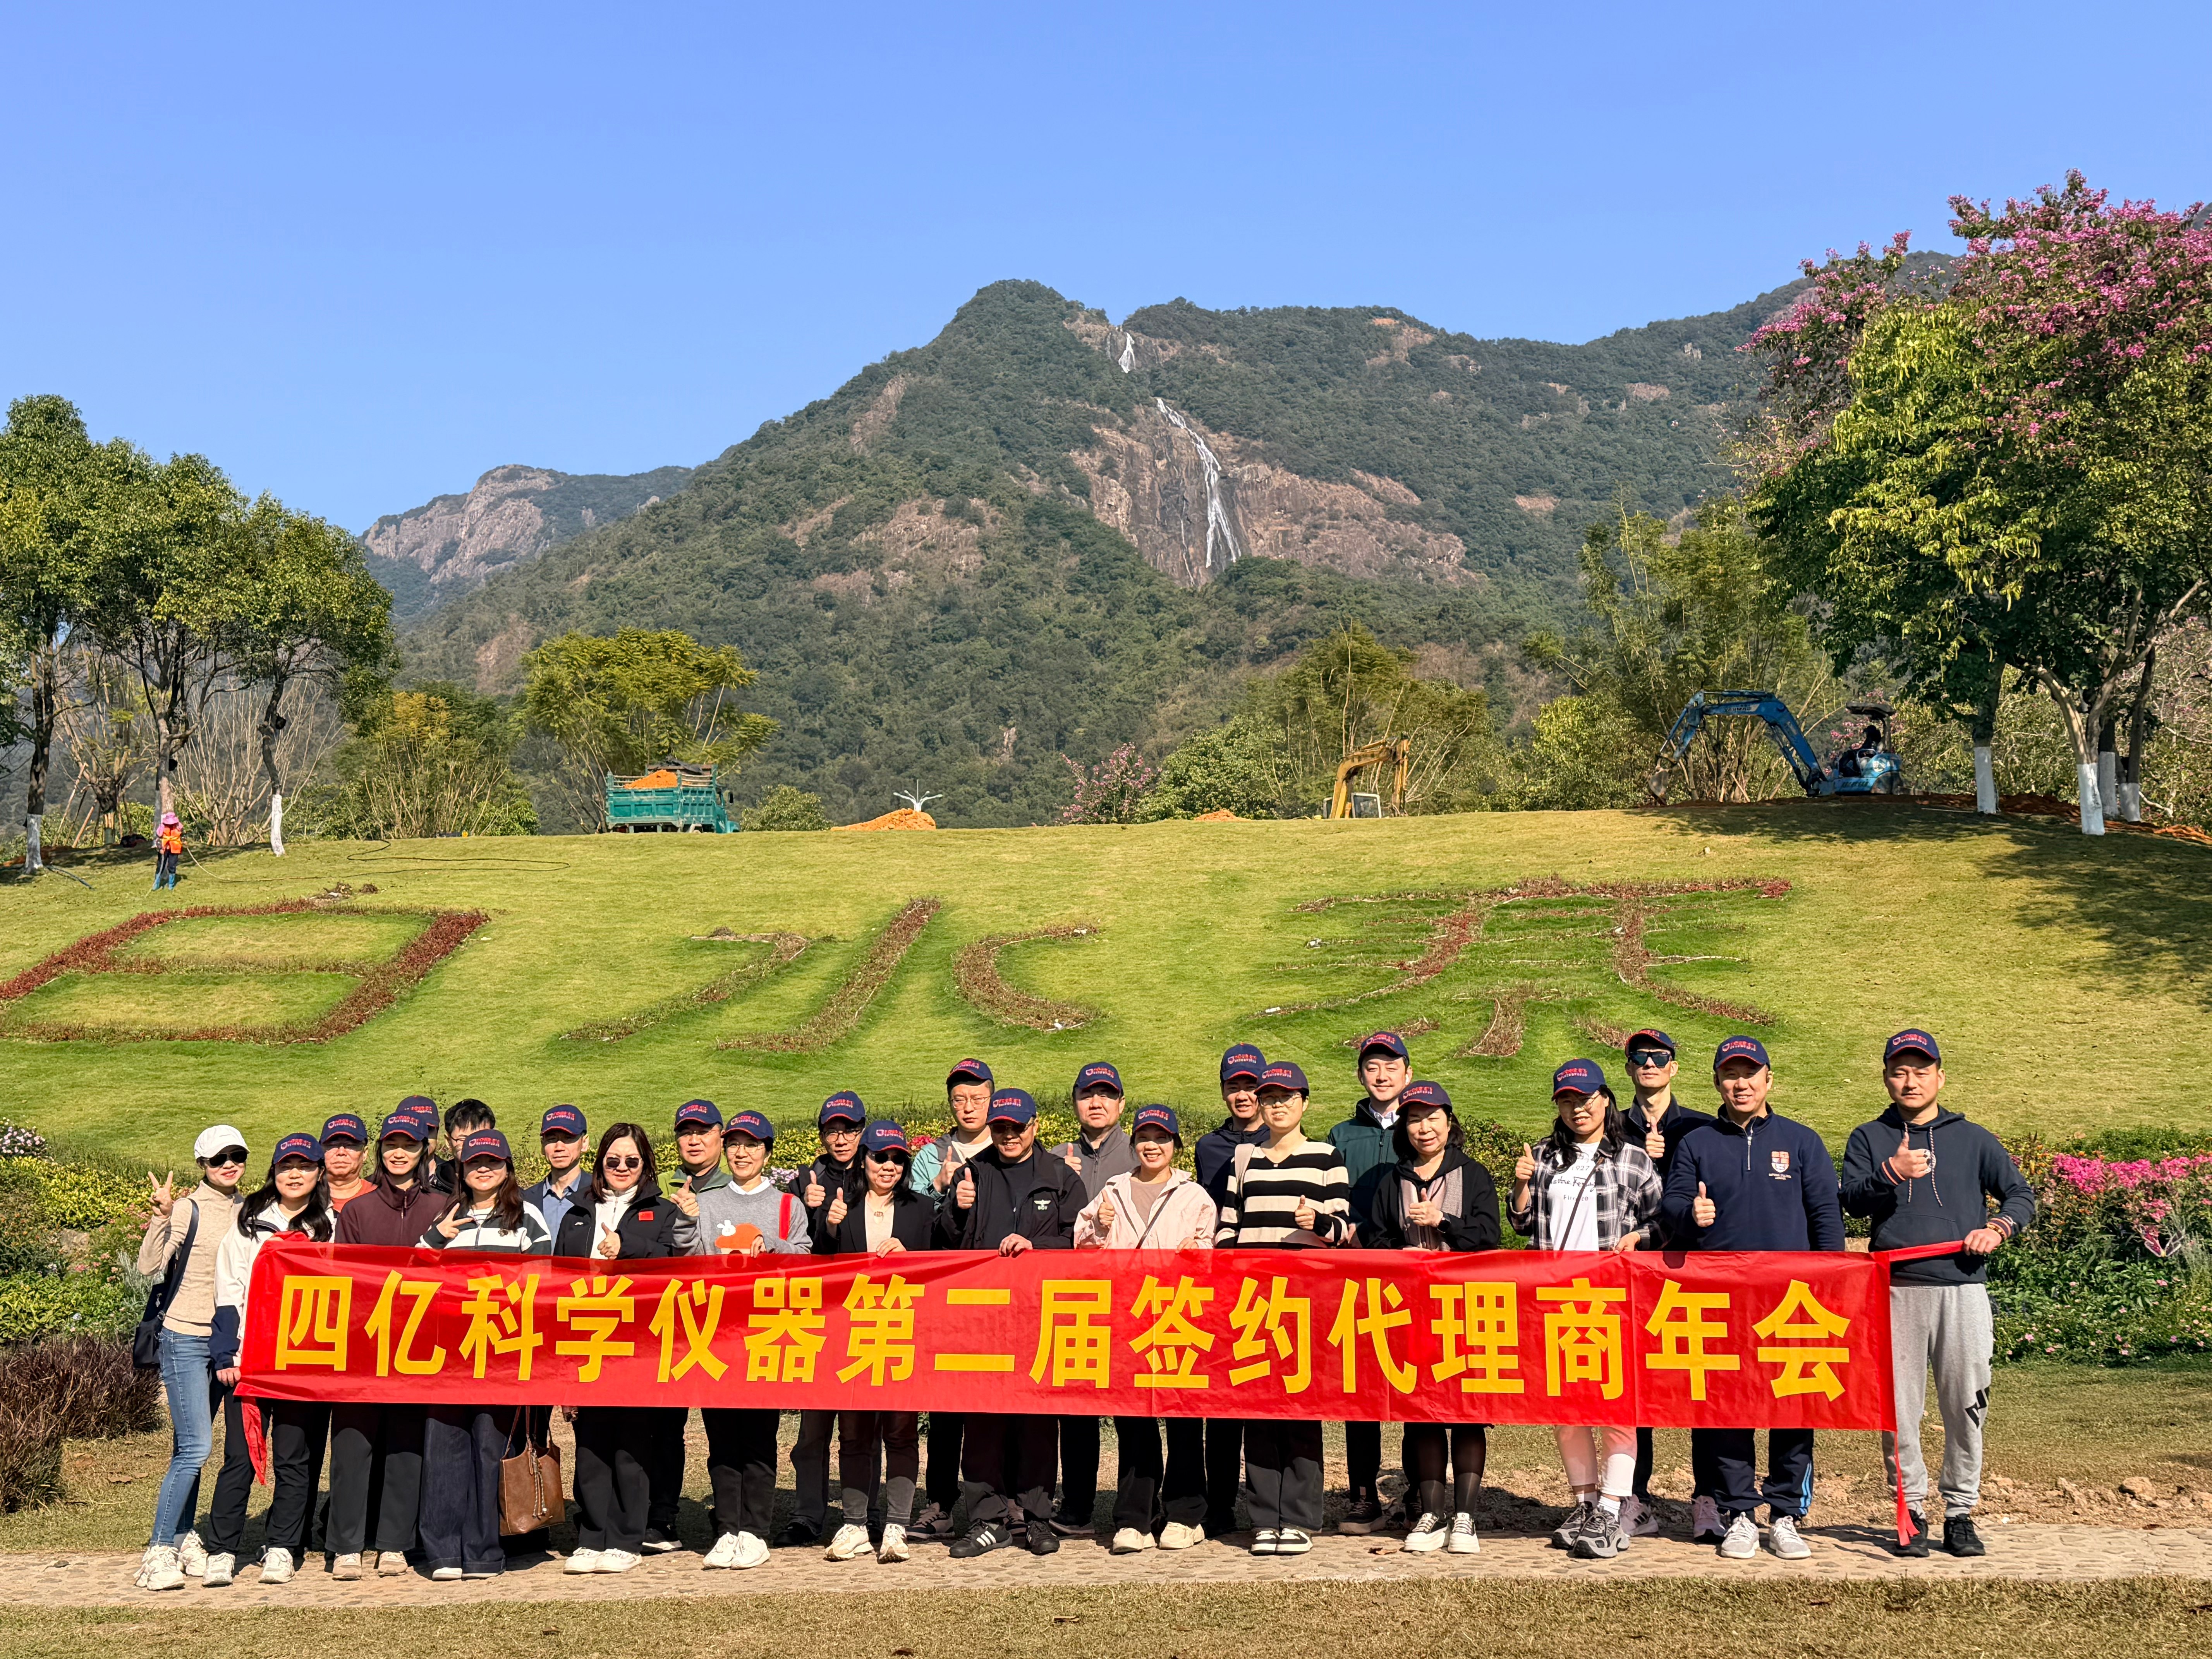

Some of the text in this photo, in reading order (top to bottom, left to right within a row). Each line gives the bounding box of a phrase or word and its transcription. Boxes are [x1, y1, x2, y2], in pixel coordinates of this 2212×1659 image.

[275, 1269, 1851, 1401] 四亿科学仪器第二届签约代理商年会
